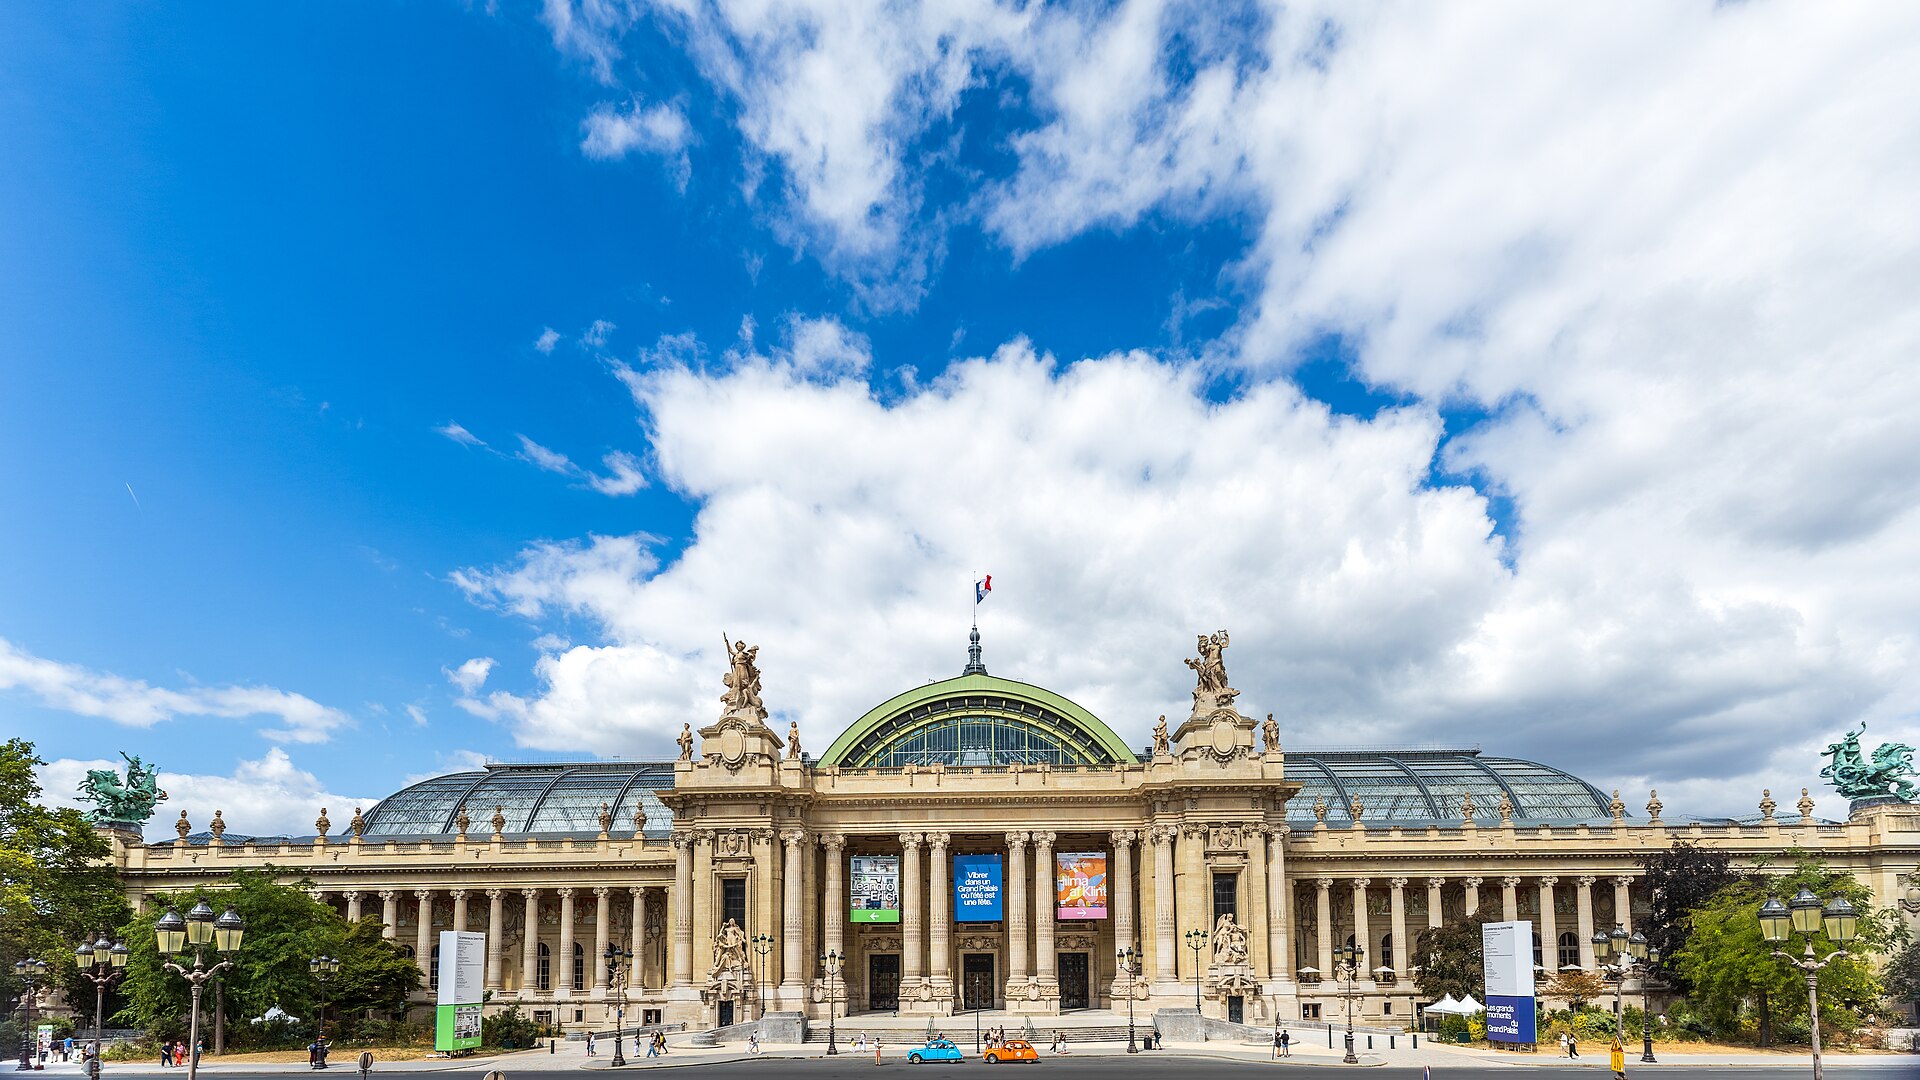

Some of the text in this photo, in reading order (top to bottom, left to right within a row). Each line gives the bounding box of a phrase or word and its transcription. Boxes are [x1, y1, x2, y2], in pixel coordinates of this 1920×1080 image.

[851, 881, 895, 891] Leandro
[1057, 876, 1088, 886] Hilma
[871, 891, 898, 901] Erlich
[1069, 886, 1107, 896] af Klint
[1486, 1003, 1514, 1012] Les grands
[1510, 1019, 1519, 1027] du
[1488, 1024, 1519, 1034] Grand Palais
